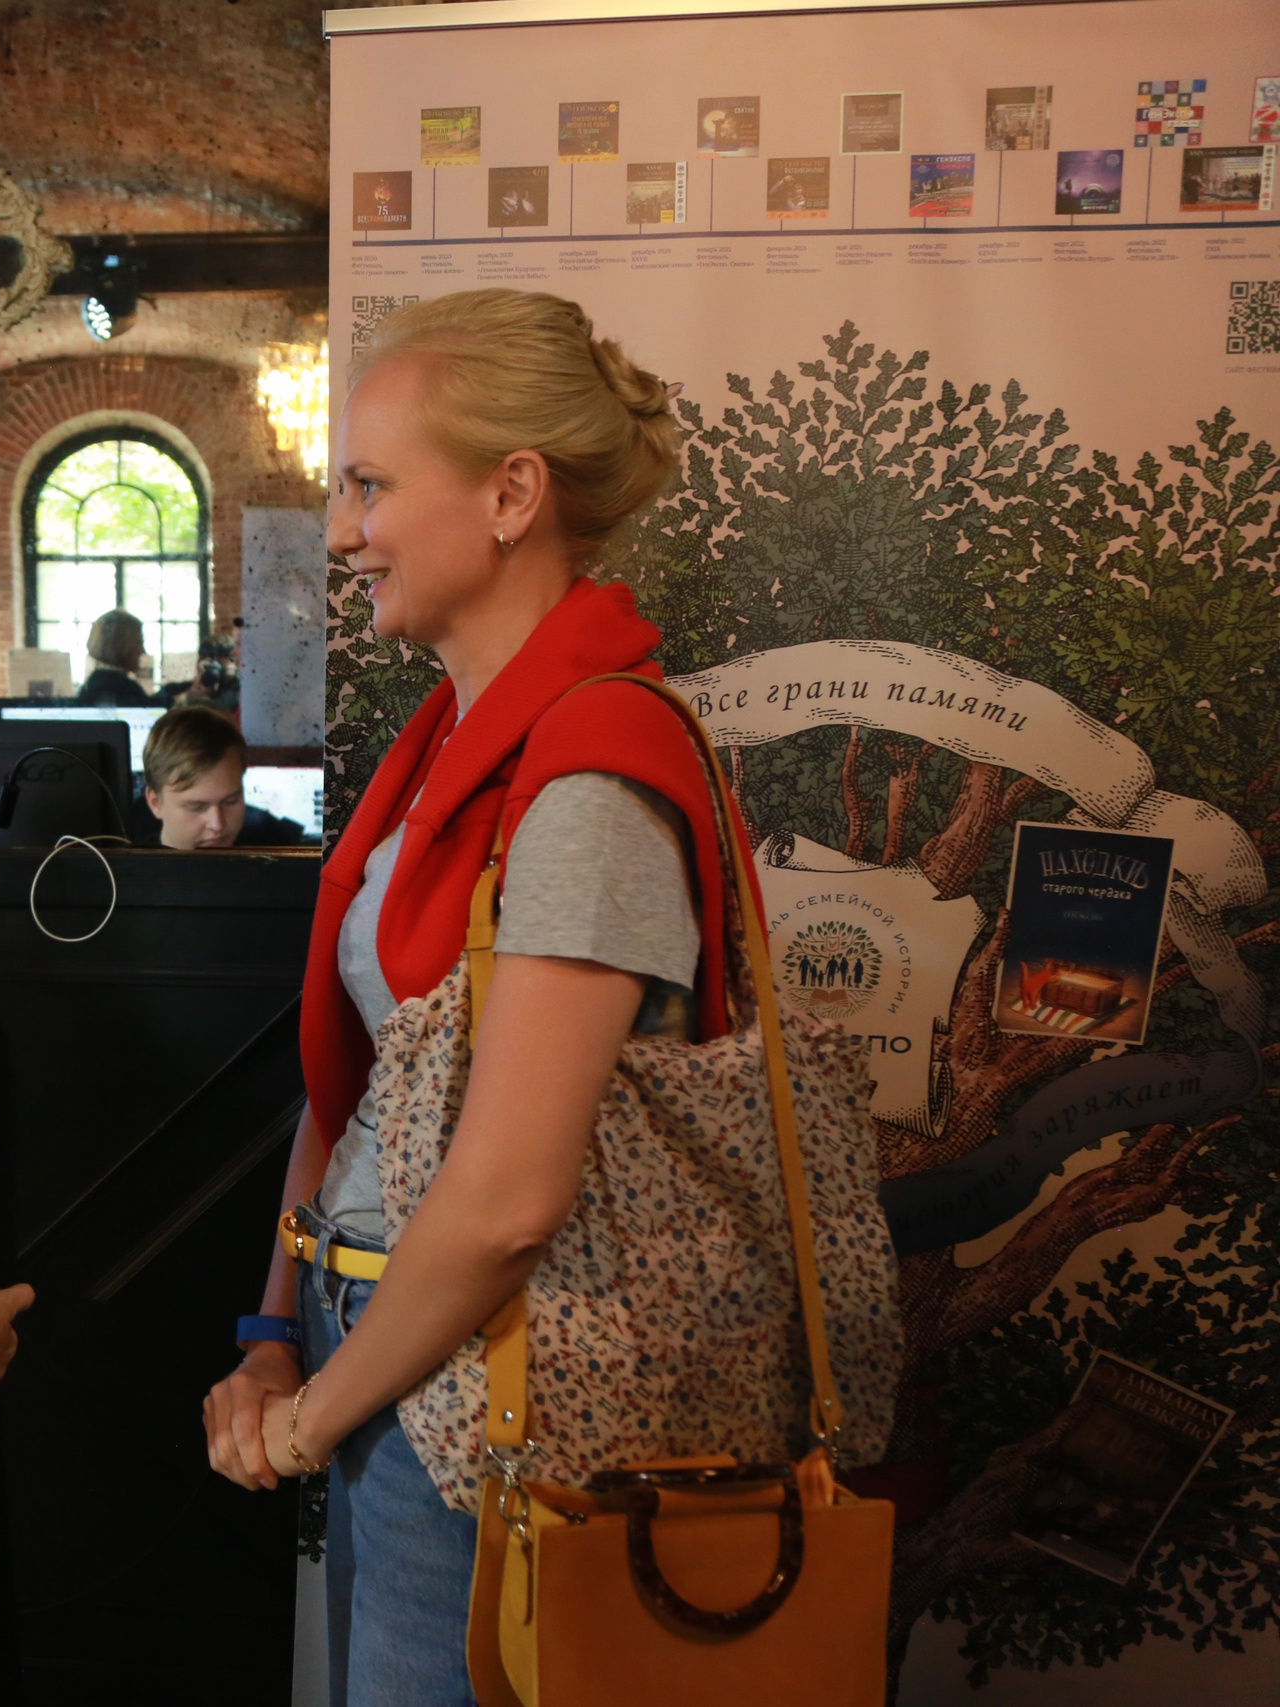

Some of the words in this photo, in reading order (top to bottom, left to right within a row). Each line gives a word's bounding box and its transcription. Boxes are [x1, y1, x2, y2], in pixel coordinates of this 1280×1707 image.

[377, 205, 389, 216] 75
[690, 689, 748, 718] Все
[766, 679, 868, 711] грани
[886, 680, 1029, 732] памяти
[1042, 883, 1085, 896] старого
[1087, 887, 1132, 900] чердака
[795, 893, 896, 927] СЕМЕЙНОЙ
[888, 932, 912, 1015] ИСТОРИИ
[1029, 1076, 1201, 1148] заряжает
[1112, 1387, 1212, 1442] ГЕНЭКСПО
[1126, 1373, 1219, 1428] АЛЬМАНАХ
